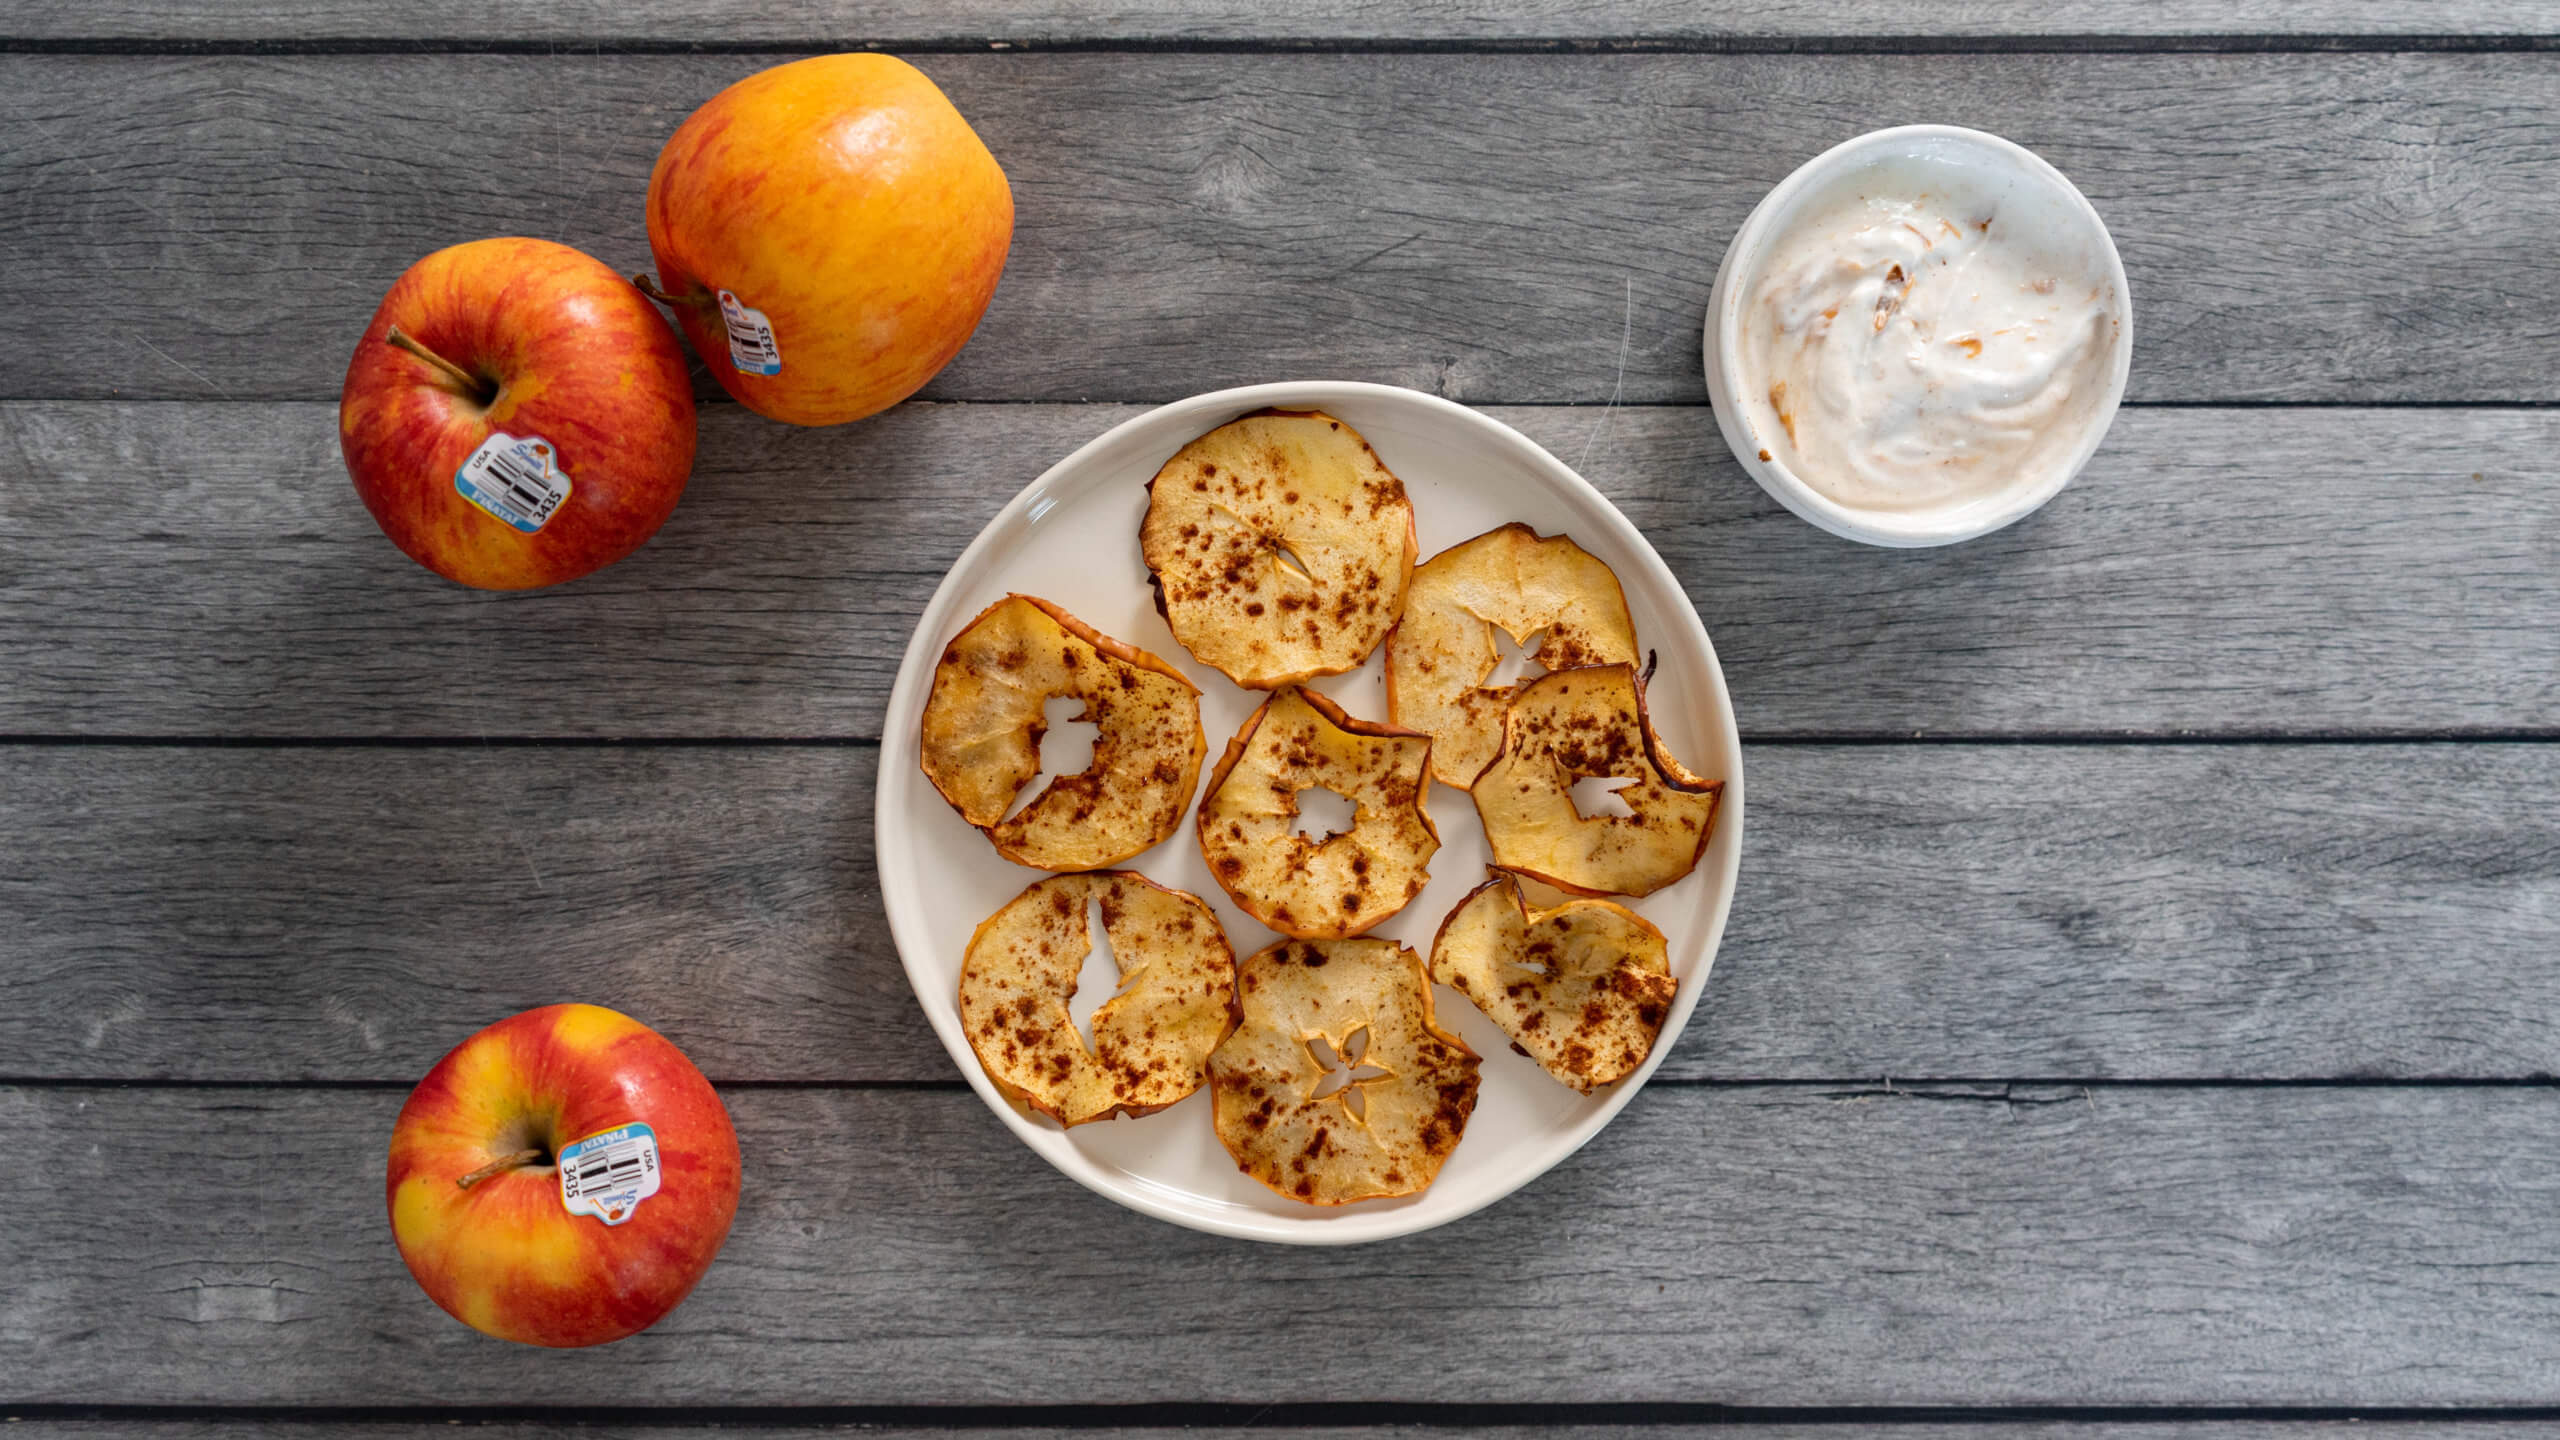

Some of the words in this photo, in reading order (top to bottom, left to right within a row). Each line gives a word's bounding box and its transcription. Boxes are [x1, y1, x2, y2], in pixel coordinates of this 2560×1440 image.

[758, 327, 778, 359] 3435
[472, 450, 491, 469] USA
[533, 490, 562, 522] 3435
[643, 1149, 655, 1172] USA
[563, 1165, 580, 1199] 3435
